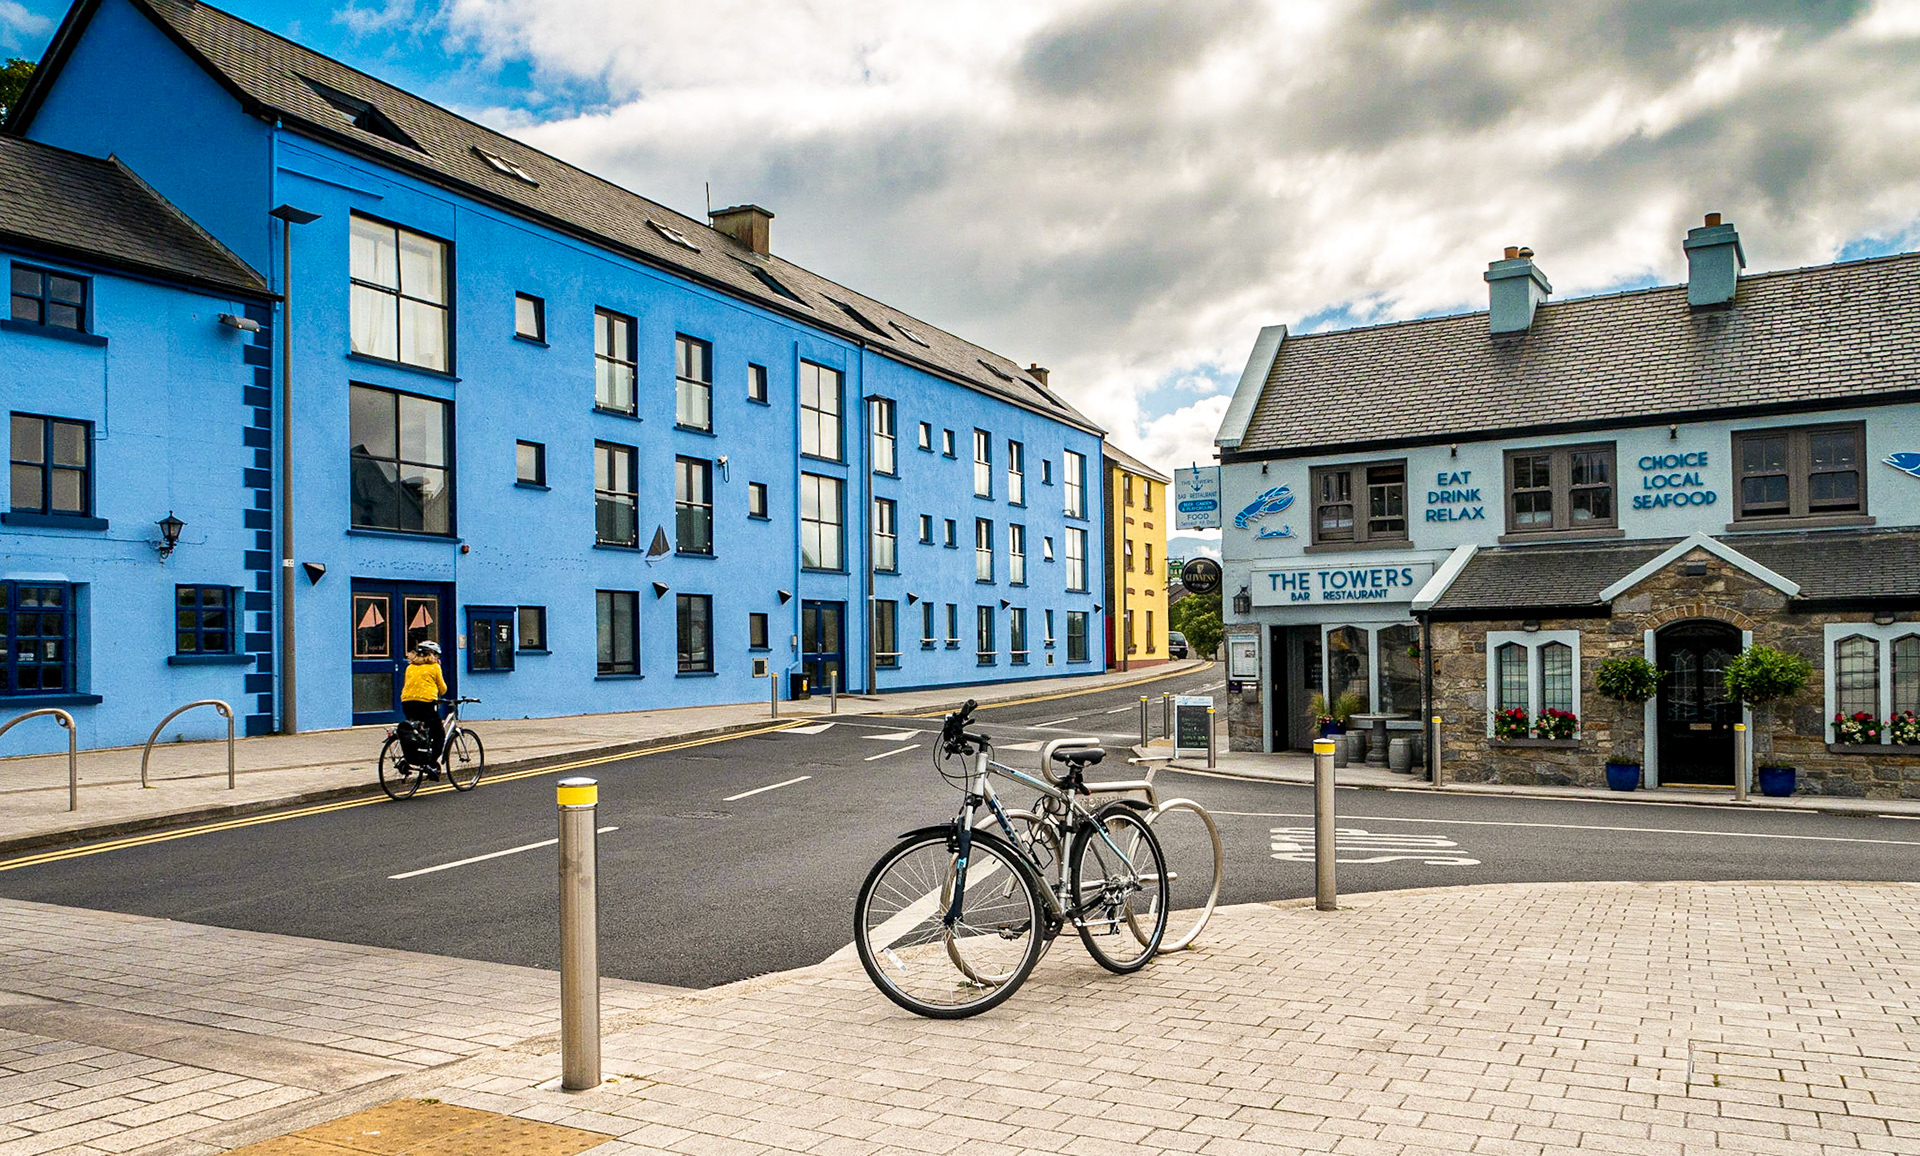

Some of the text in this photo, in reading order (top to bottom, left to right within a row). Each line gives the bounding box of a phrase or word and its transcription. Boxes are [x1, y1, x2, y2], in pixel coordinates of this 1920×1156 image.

[1638, 451, 1708, 471] CHOICE
[1437, 471, 1472, 487] EAT
[1644, 472, 1704, 490] LOCAL
[1189, 490, 1217, 499] RESTAURANT
[1428, 488, 1481, 505] DRINK
[1633, 490, 1717, 510] SEAFOOD
[1425, 506, 1486, 523] RELAX
[1185, 573, 1216, 582] GUINNESS
[1268, 567, 1414, 591] THE TOWERS
[1290, 588, 1387, 601] BAR RESTAURANT
